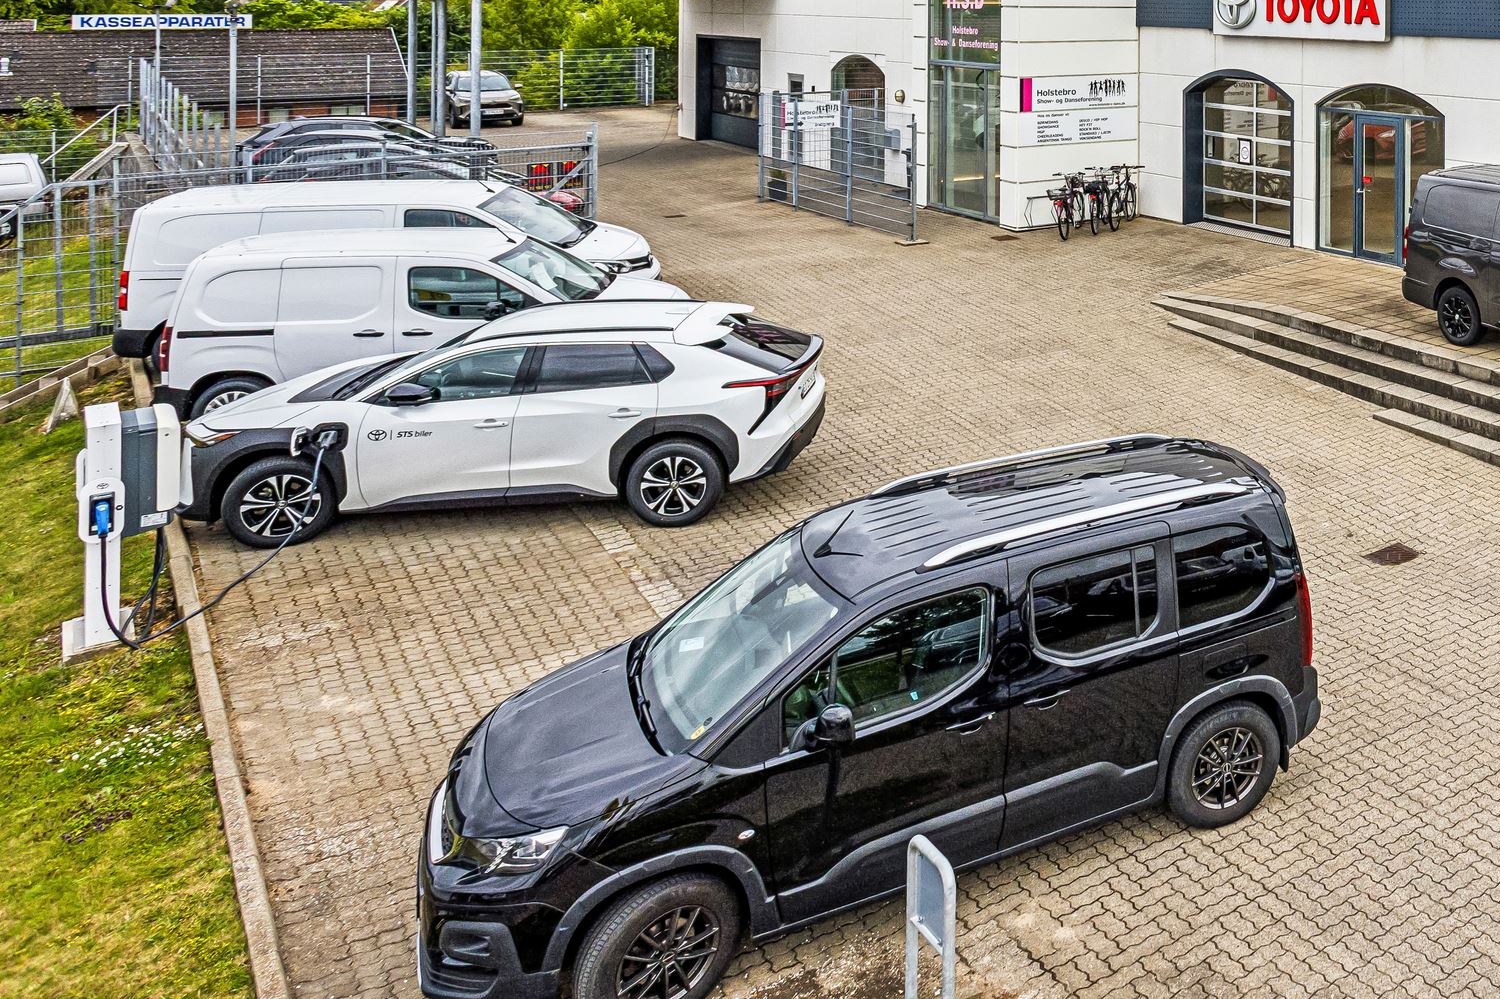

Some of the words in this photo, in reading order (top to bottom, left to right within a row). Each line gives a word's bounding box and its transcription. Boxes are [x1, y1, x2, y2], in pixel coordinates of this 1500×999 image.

[80, 16, 246, 28] KASSEAPPARATER
[952, 26, 978, 34] Holstebro
[959, 39, 998, 51] Danseforening
[1036, 88, 1076, 97] Holstebro
